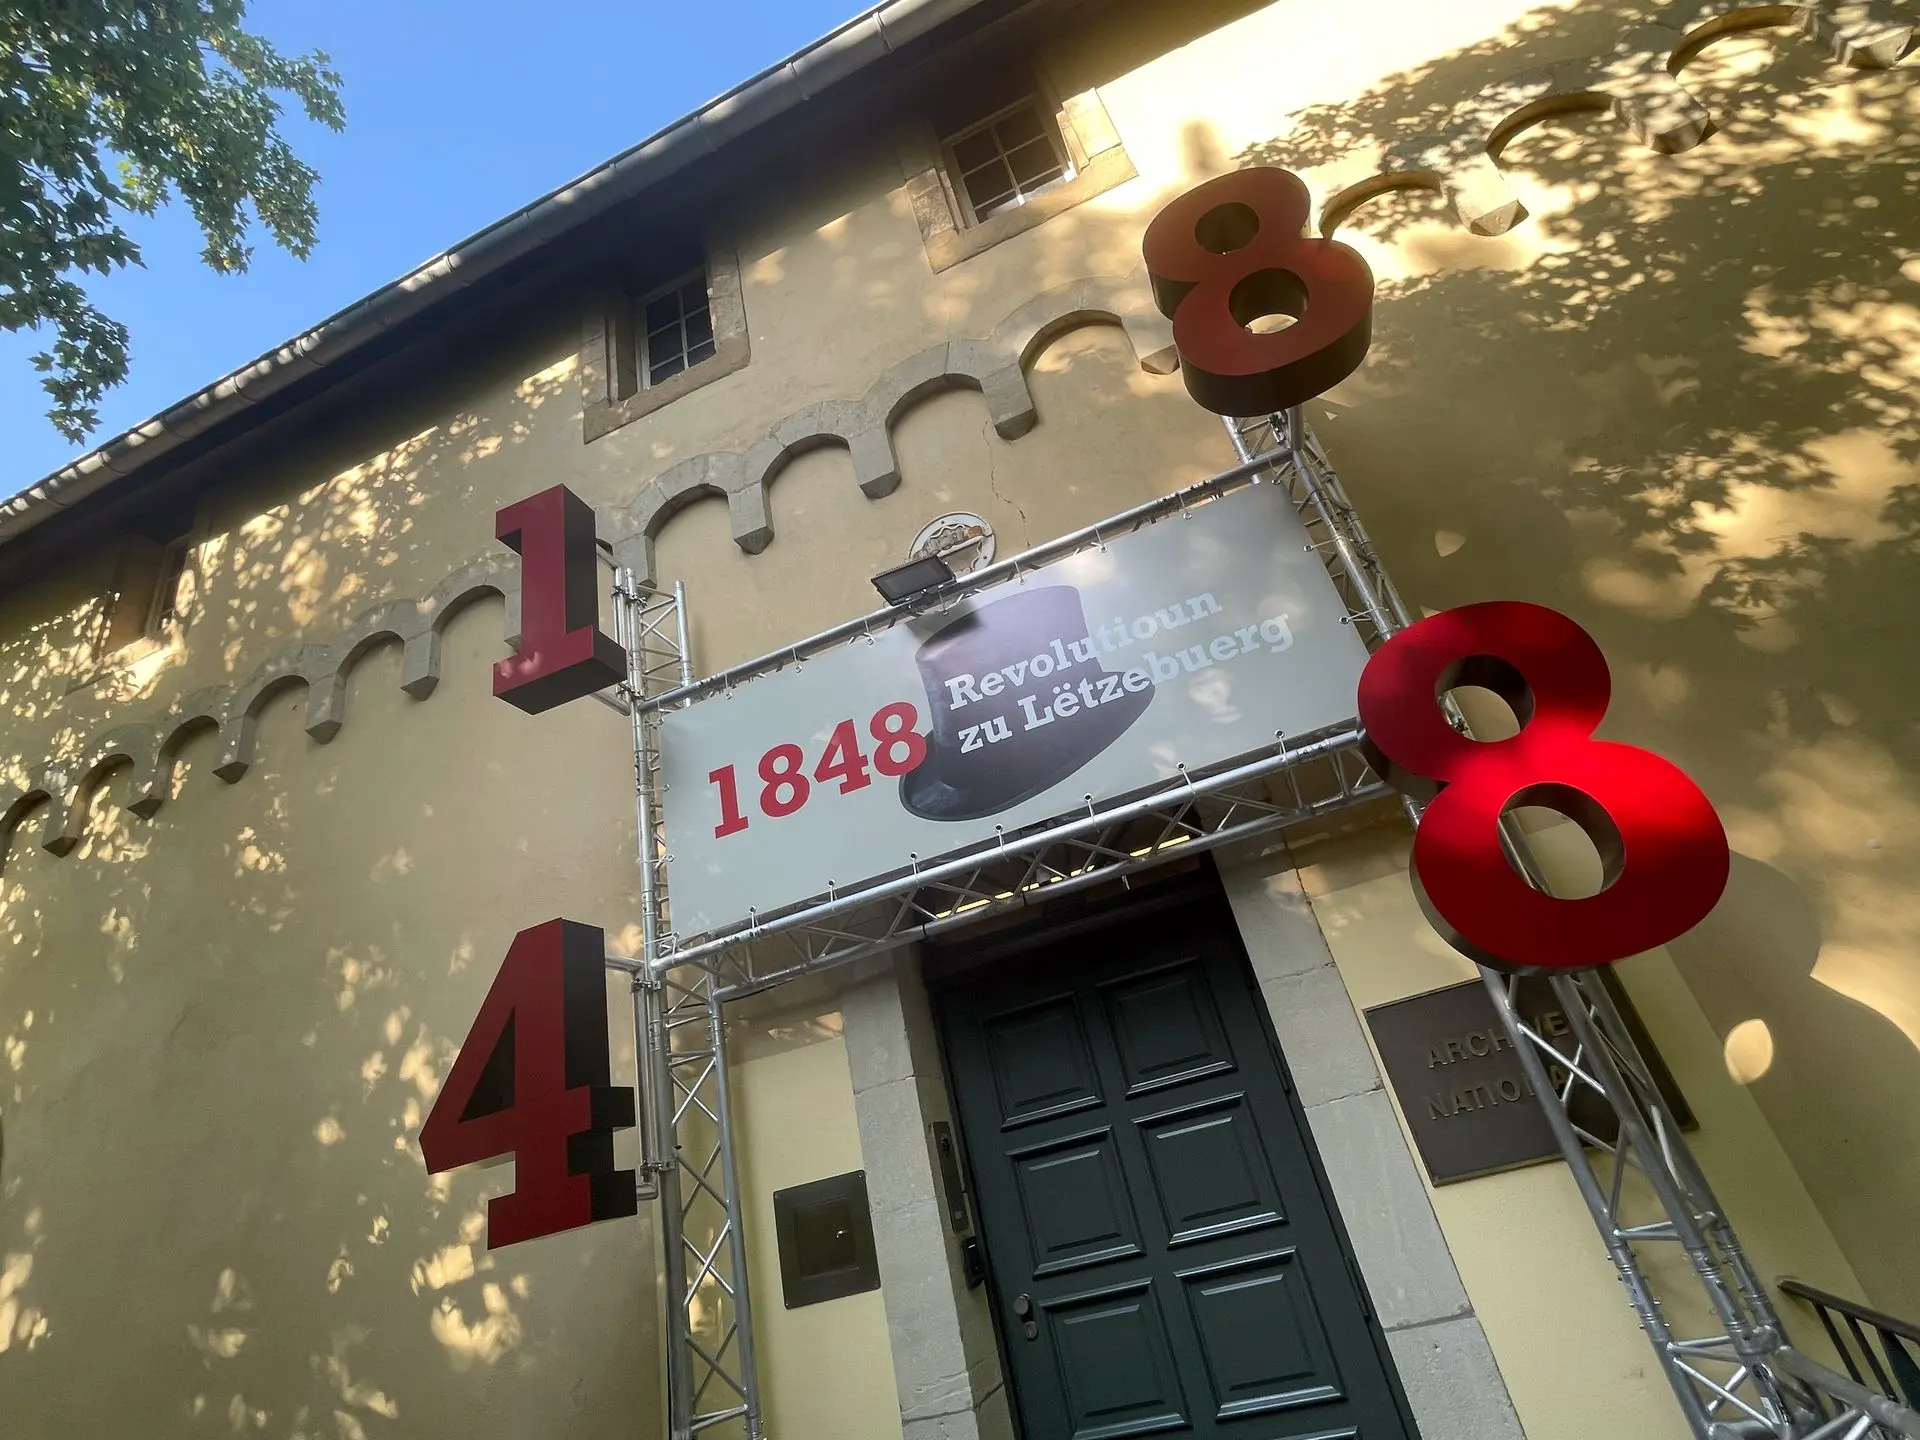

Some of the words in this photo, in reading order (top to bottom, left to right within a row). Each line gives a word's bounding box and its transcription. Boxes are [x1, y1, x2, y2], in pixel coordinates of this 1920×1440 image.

[1143, 166, 1374, 380] 8
[493, 484, 598, 700] 1
[944, 590, 1224, 711] Revolutioun
[708, 701, 928, 839] 1848
[957, 715, 1013, 753] zu
[1018, 613, 1295, 731] Lëtzebuerg
[1357, 601, 1730, 968] 8
[419, 918, 596, 1250] 4
[1428, 1009, 1574, 1069] ARCHE
